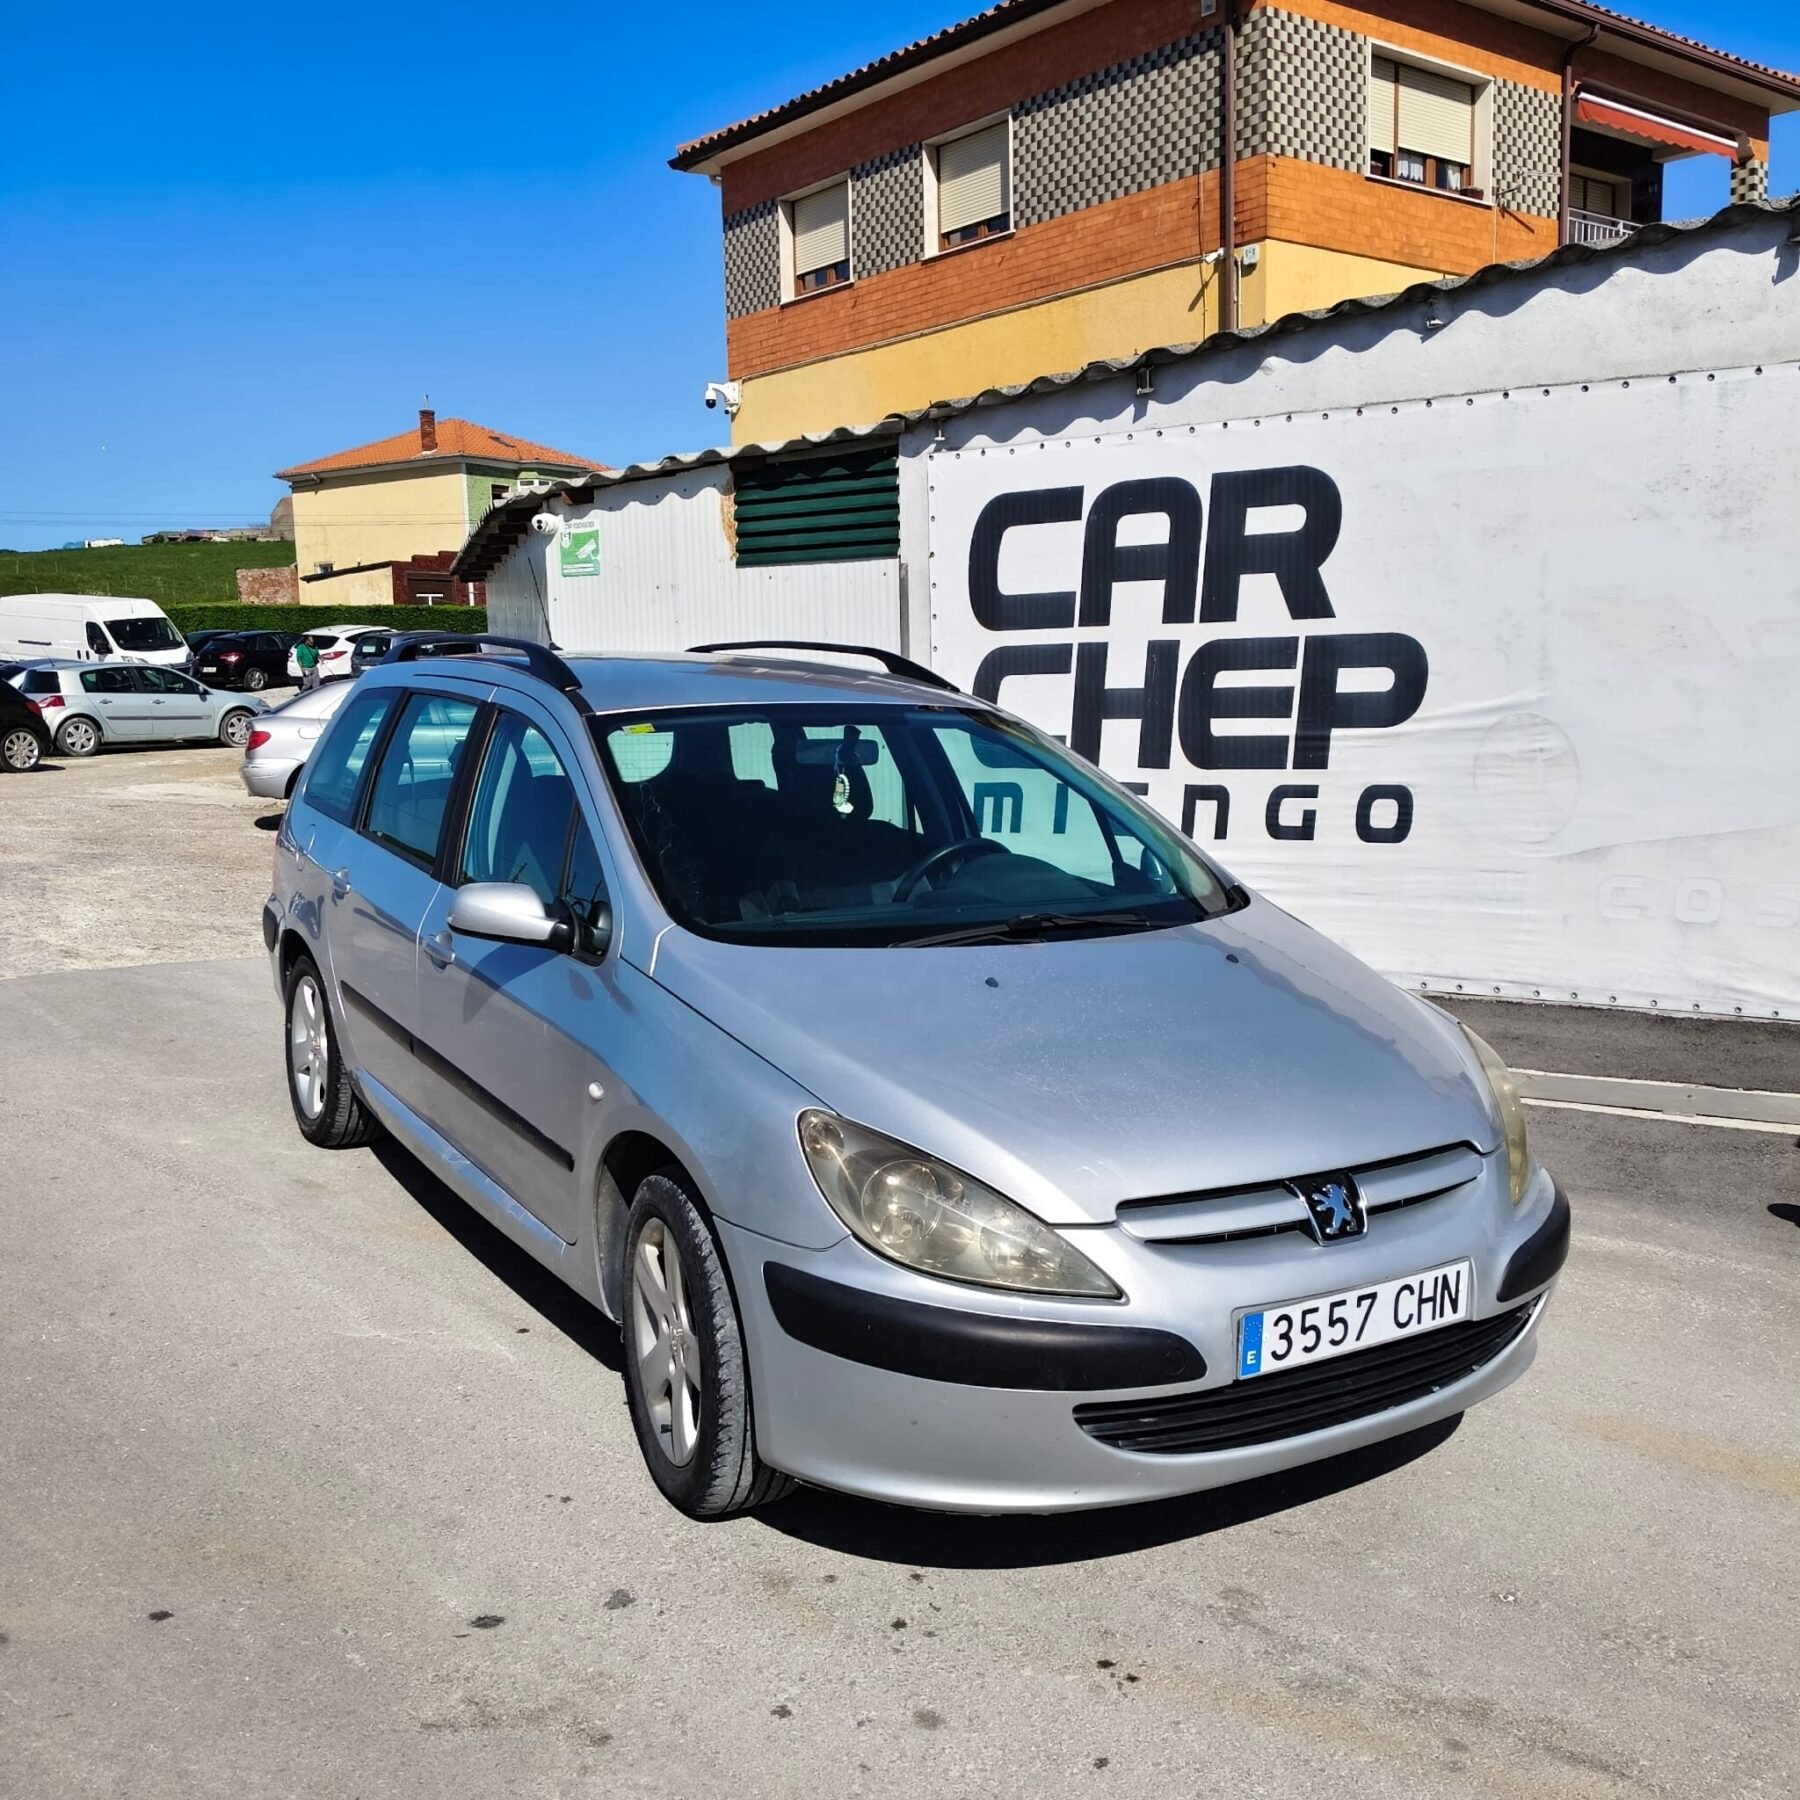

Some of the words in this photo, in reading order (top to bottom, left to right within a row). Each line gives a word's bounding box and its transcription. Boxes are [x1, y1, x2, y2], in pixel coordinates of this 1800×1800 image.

[969, 465, 1343, 632] CAR
[971, 632, 1429, 770] CHEP
[1246, 1350, 1257, 1365] E
[1271, 1291, 1378, 1362] 3557
[1393, 1270, 1461, 1330] CHN
